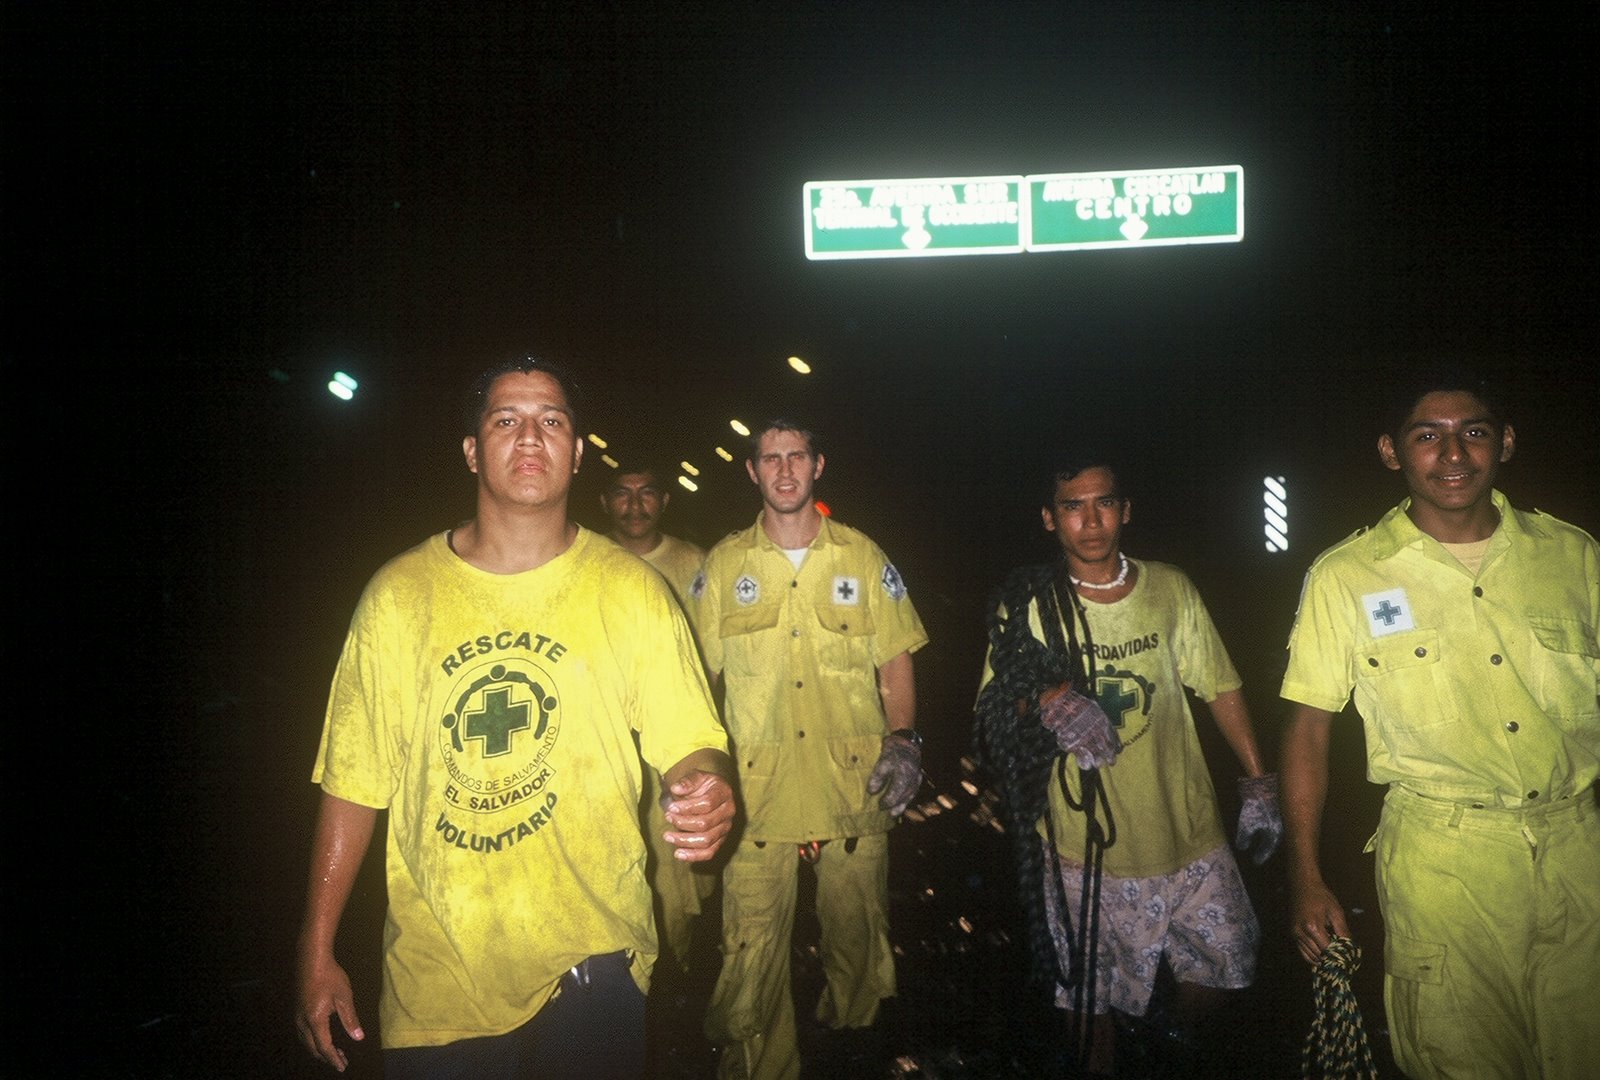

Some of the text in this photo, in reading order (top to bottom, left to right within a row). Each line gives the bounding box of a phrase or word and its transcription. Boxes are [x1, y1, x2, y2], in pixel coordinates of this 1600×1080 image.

[1076, 194, 1192, 219] CENTRO
[441, 631, 567, 677] RESCATE
[1080, 632, 1159, 660] ARDAVIDAS
[442, 726, 557, 791] COMANDOS DE SALVAMENTO
[444, 768, 551, 811] EL SALVADOR
[435, 791, 558, 853] VOLUNTARIO
